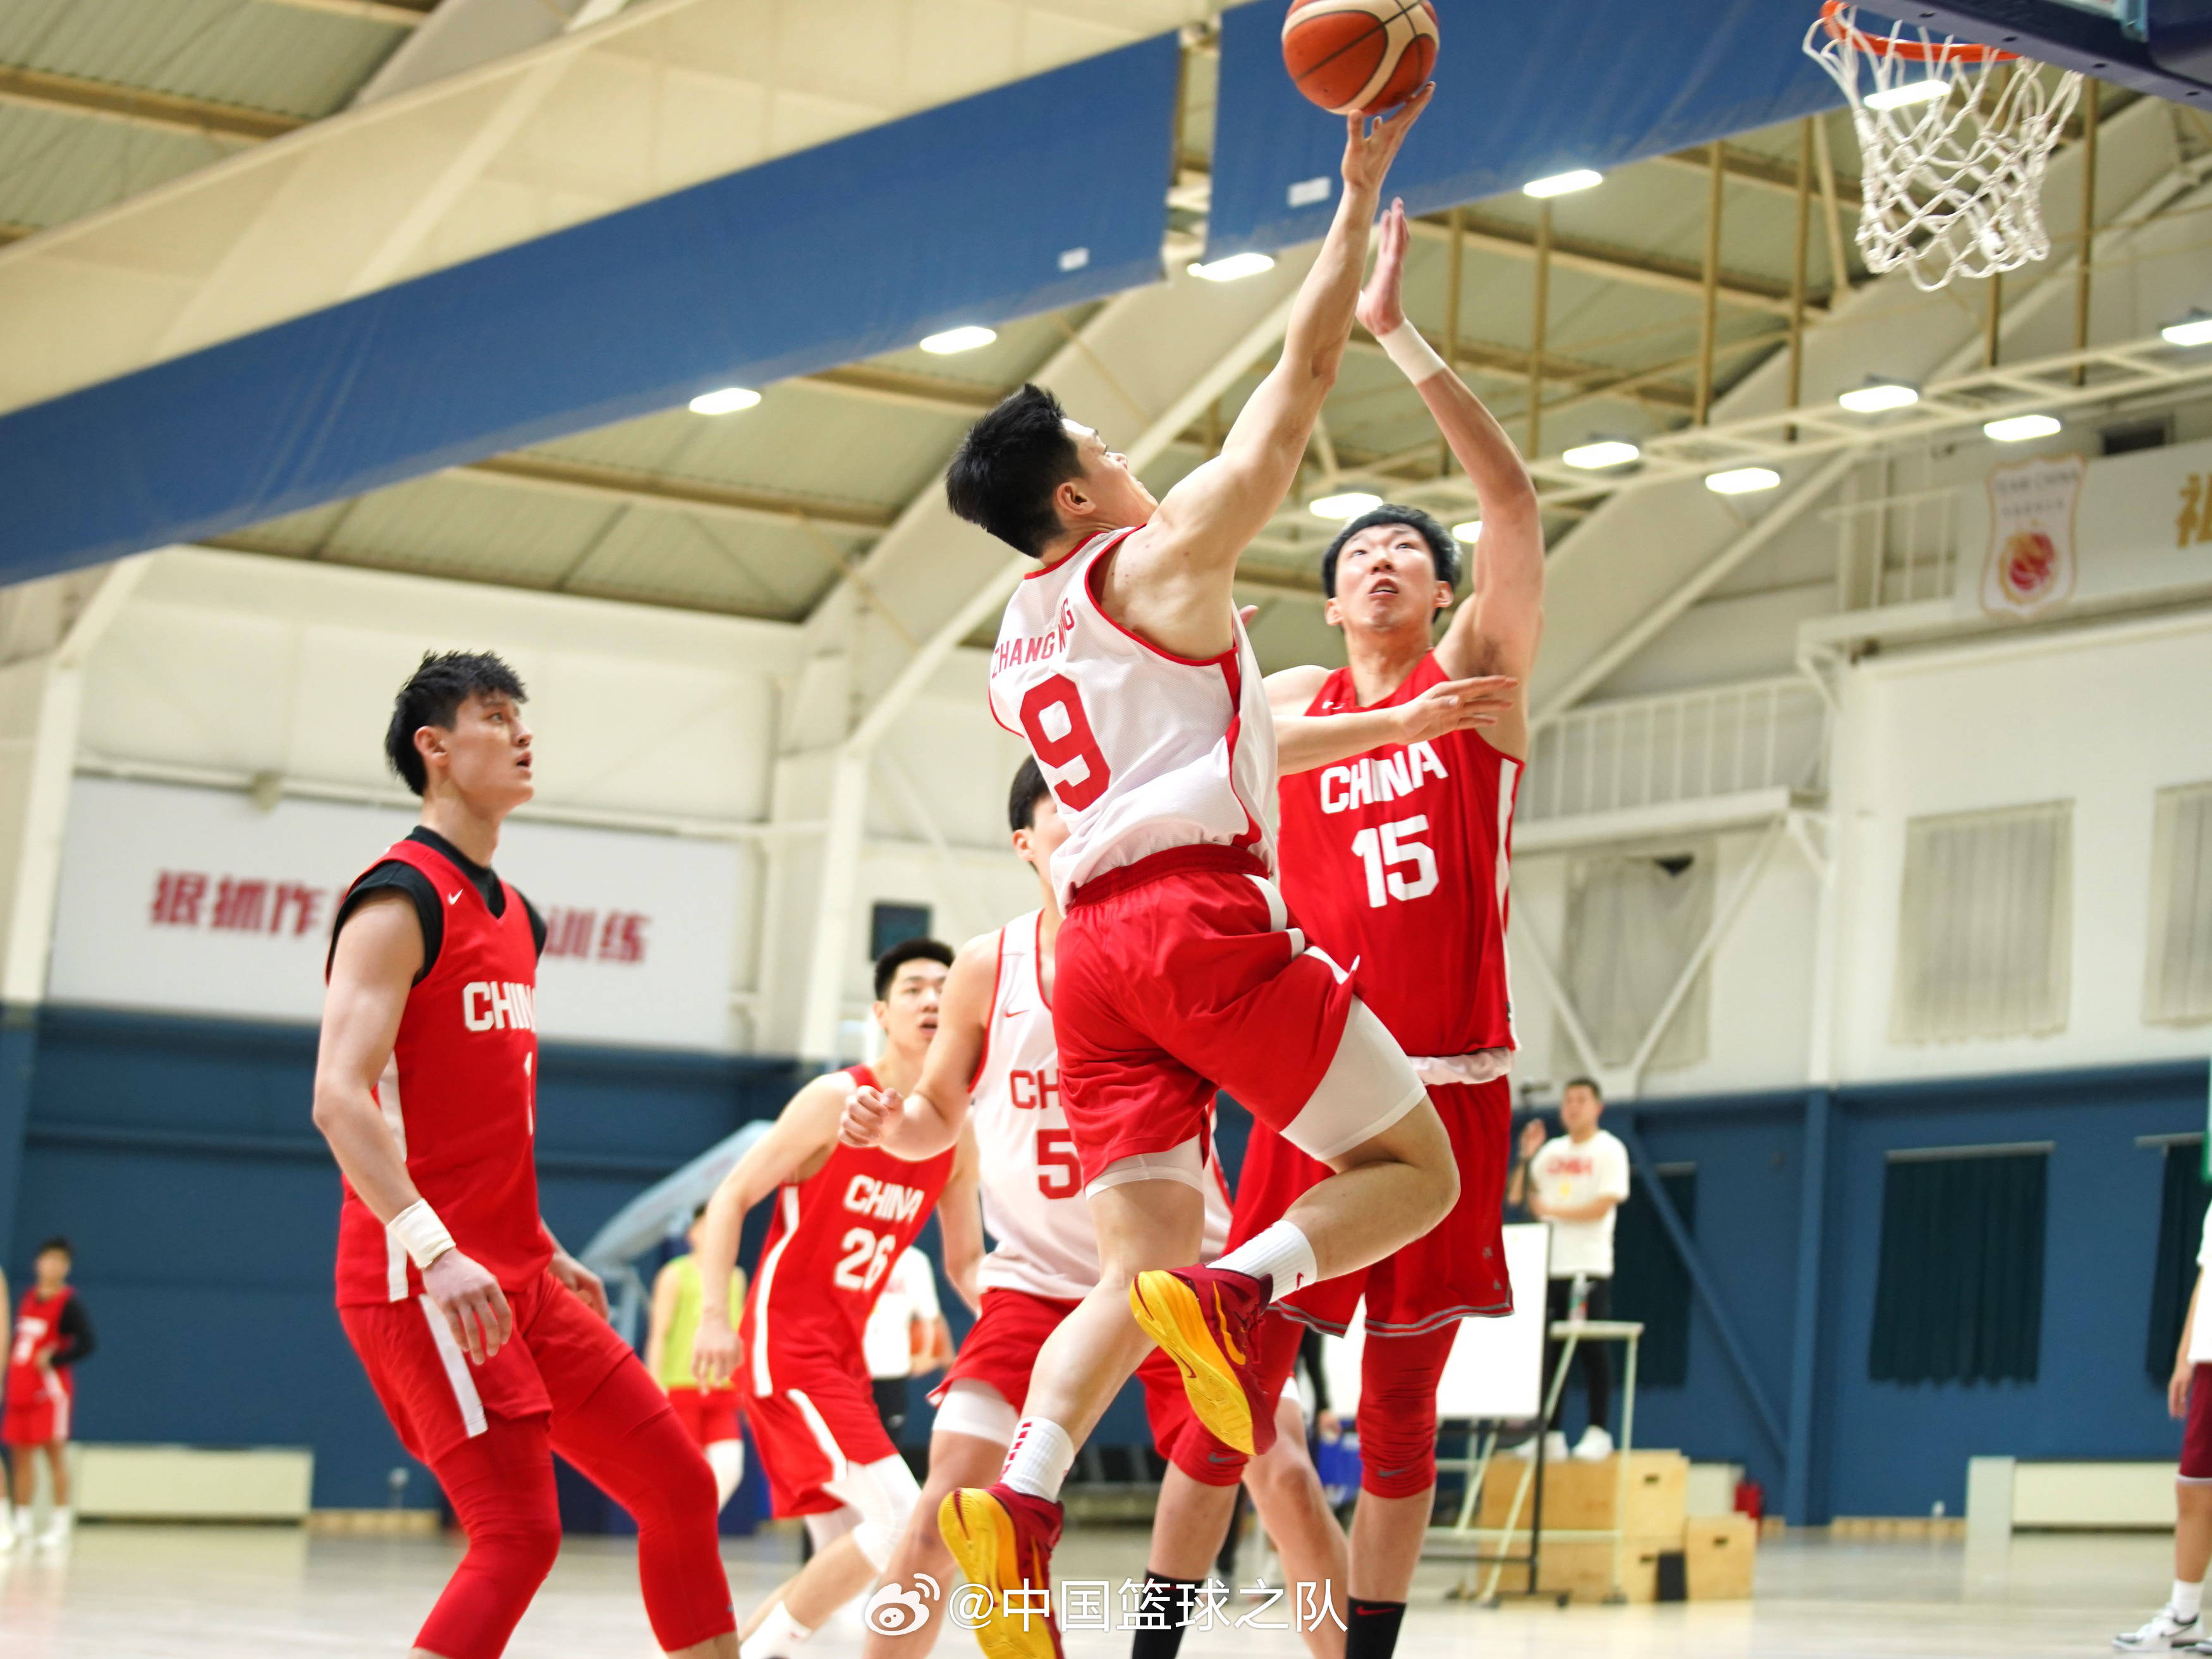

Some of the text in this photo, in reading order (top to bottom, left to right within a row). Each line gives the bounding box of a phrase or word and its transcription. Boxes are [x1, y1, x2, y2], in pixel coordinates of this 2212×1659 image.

[992, 632, 1055, 679] ZHANG
[1020, 673, 1111, 812] 9
[1321, 740, 1448, 814] CHINA
[1351, 814, 1439, 908] 15
[463, 981, 536, 1032] CHIN
[1037, 1128, 1082, 1199] 5
[845, 1174, 924, 1222] CHINA
[834, 1227, 896, 1292] 26
